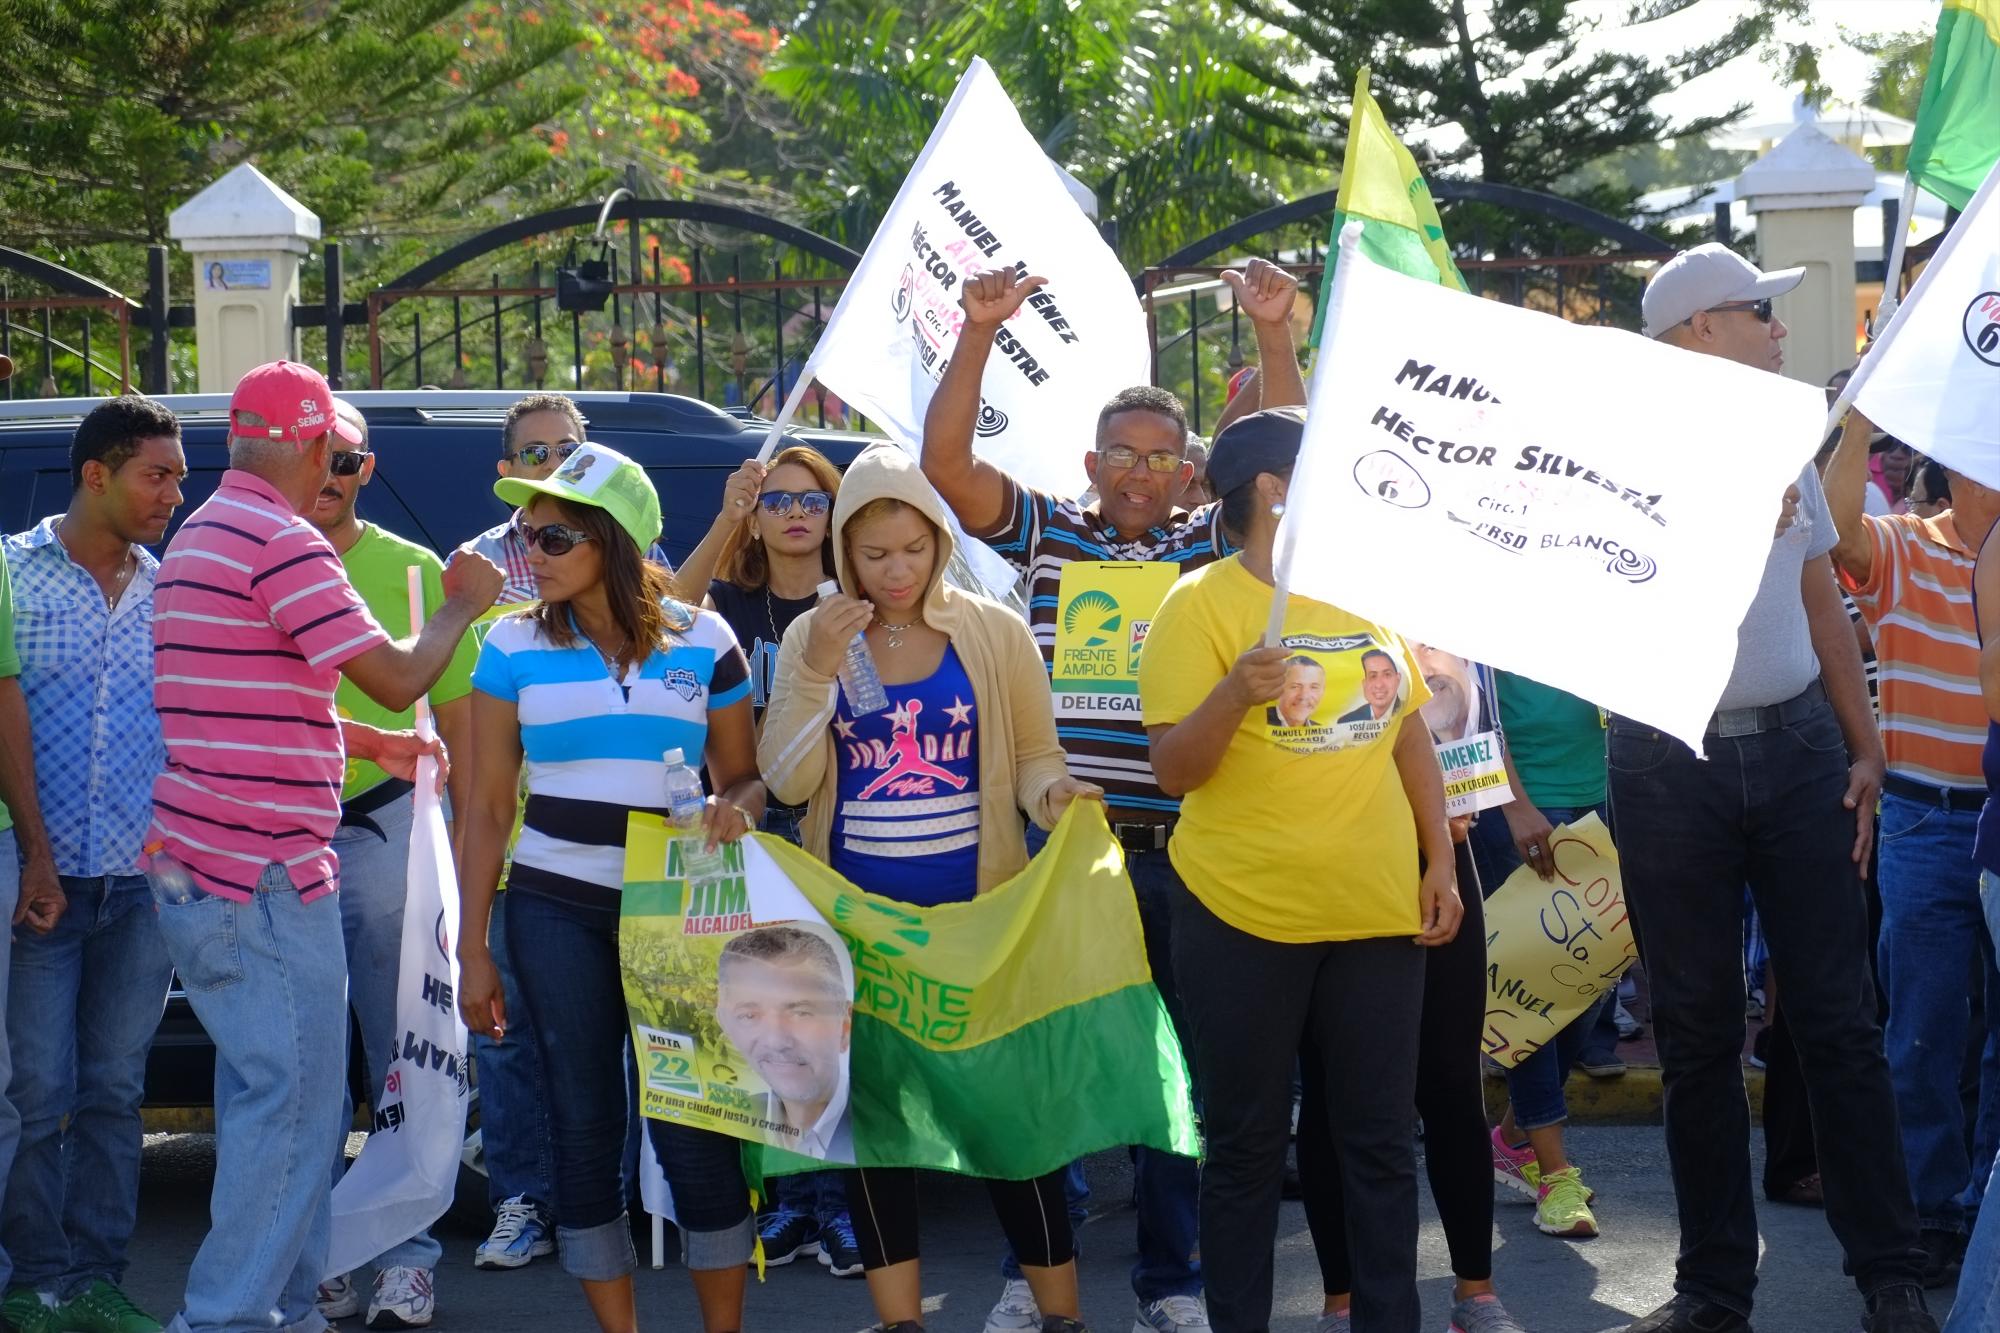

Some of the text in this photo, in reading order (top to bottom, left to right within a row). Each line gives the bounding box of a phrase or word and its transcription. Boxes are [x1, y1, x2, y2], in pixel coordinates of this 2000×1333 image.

[932, 180, 1002, 258] MANUEL
[911, 220, 956, 291] HÉCTOR
[925, 309, 941, 332] Circ.
[1370, 405, 1497, 466] HÉCTOR
[1477, 496, 1514, 515] Circ.
[1540, 534, 1638, 565] BLANCO
[1063, 649, 1117, 661] FRENTE
[1062, 664, 1117, 676] AMPLIO
[1468, 773, 1500, 791] CREATIVA
[648, 1033, 681, 1049] VOTA
[650, 1052, 691, 1078] 22
[646, 1091, 664, 1103] Por
[665, 1097, 686, 1108] una
[687, 1100, 721, 1117] ciudad
[723, 1108, 749, 1125] justa
[751, 1117, 758, 1128] y
[758, 1118, 800, 1136] creativa
